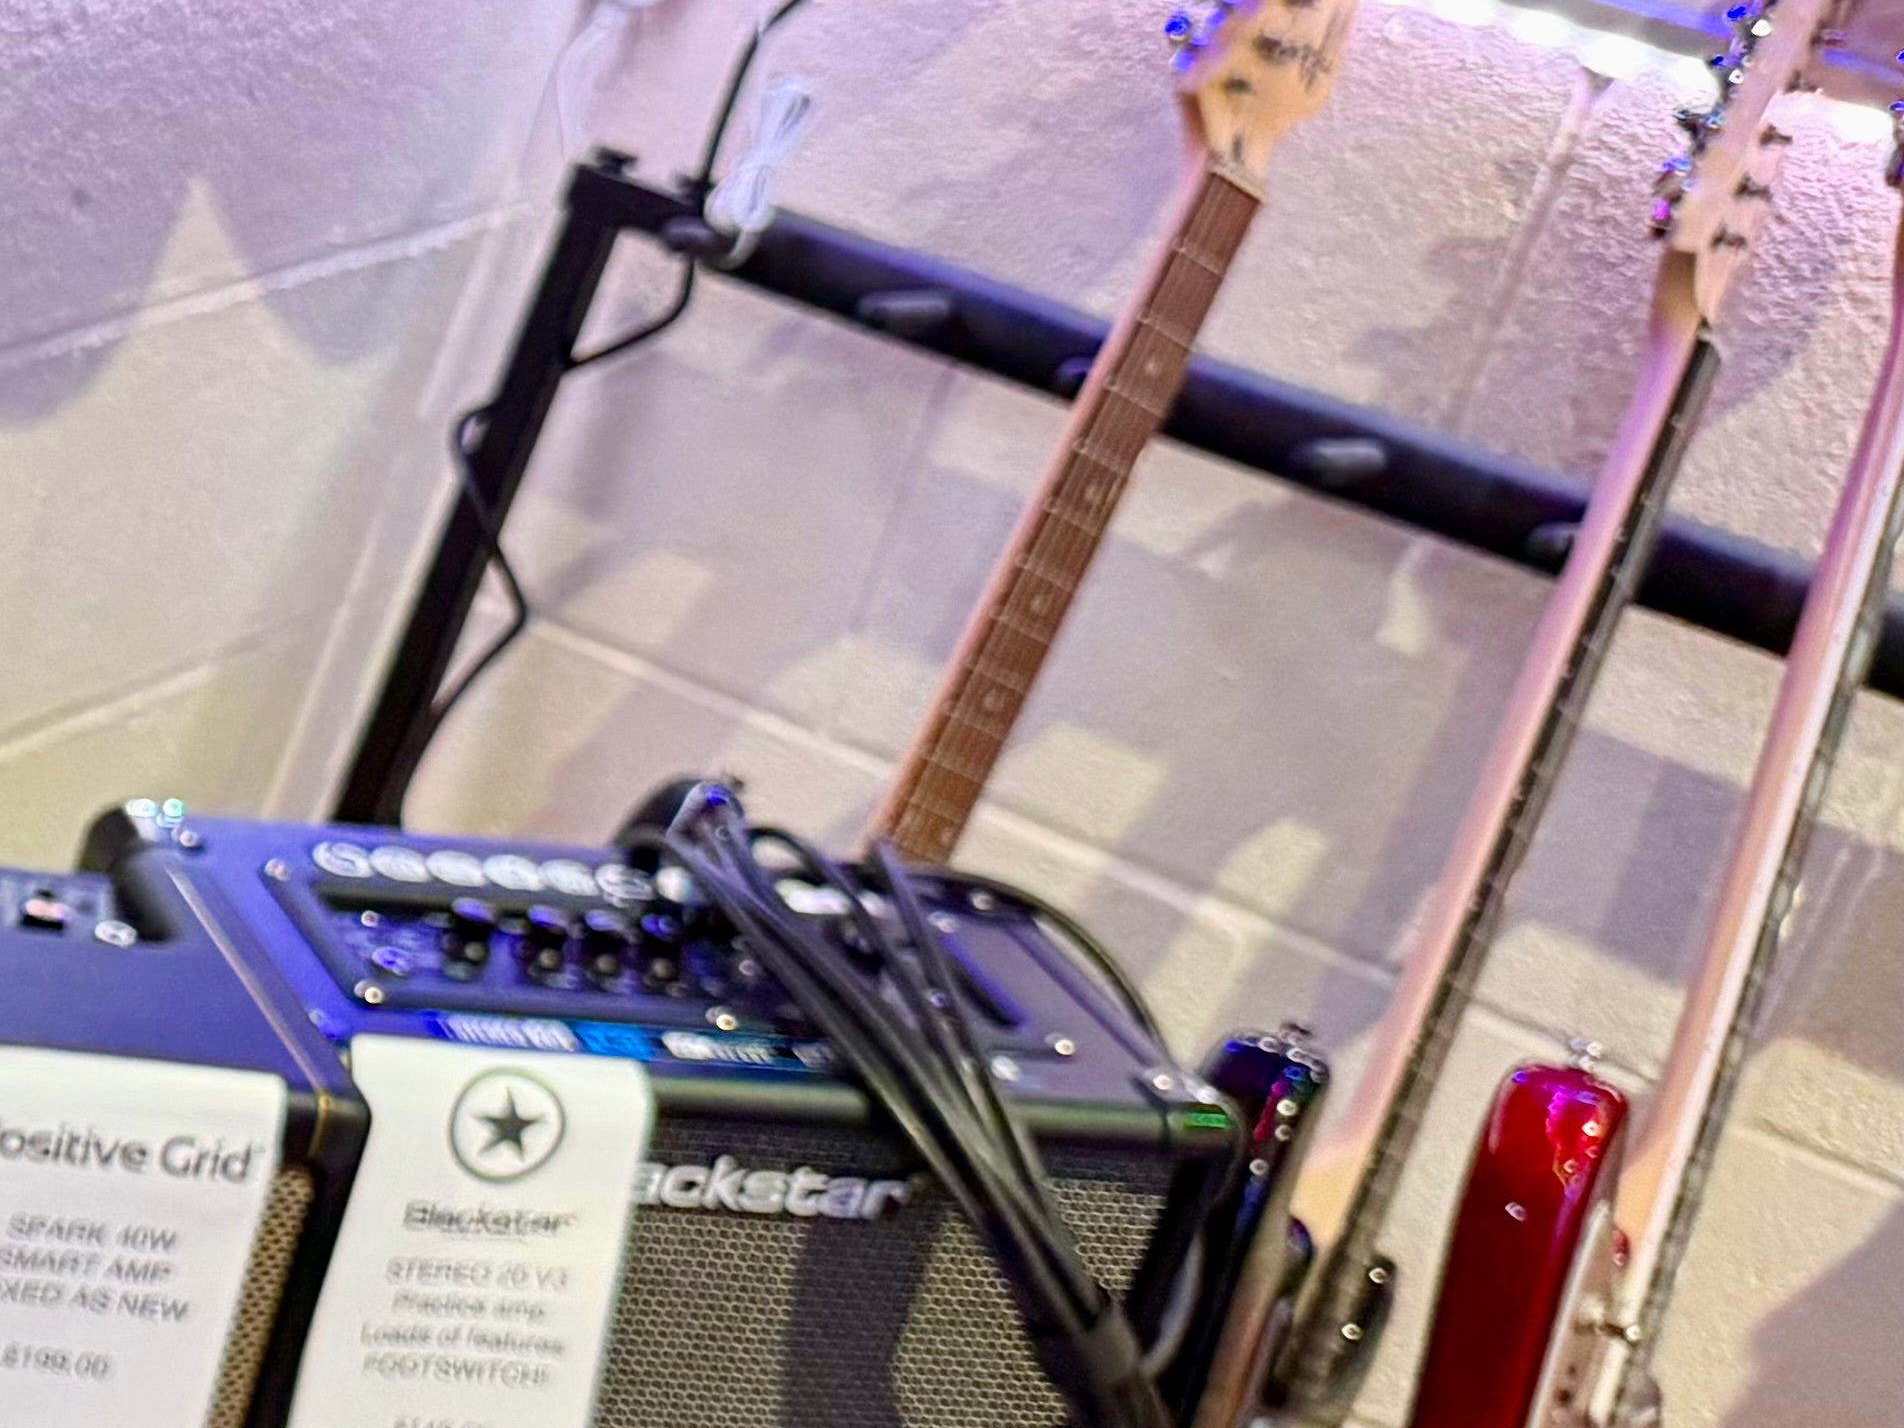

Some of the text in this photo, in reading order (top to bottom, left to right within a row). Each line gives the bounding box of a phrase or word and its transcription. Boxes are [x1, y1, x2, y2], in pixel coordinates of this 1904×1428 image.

[159, 1134, 253, 1185] Grid
[638, 1154, 909, 1219] ackstar
[6, 1211, 107, 1246] SPARK
[402, 1199, 566, 1236] Blackstar
[103, 1256, 176, 1284] AMP
[385, 1255, 491, 1288] STEREO
[68, 1283, 115, 1315] AS
[116, 1289, 189, 1322] NEW
[360, 1321, 432, 1348] Loads
[436, 1324, 461, 1349] of
